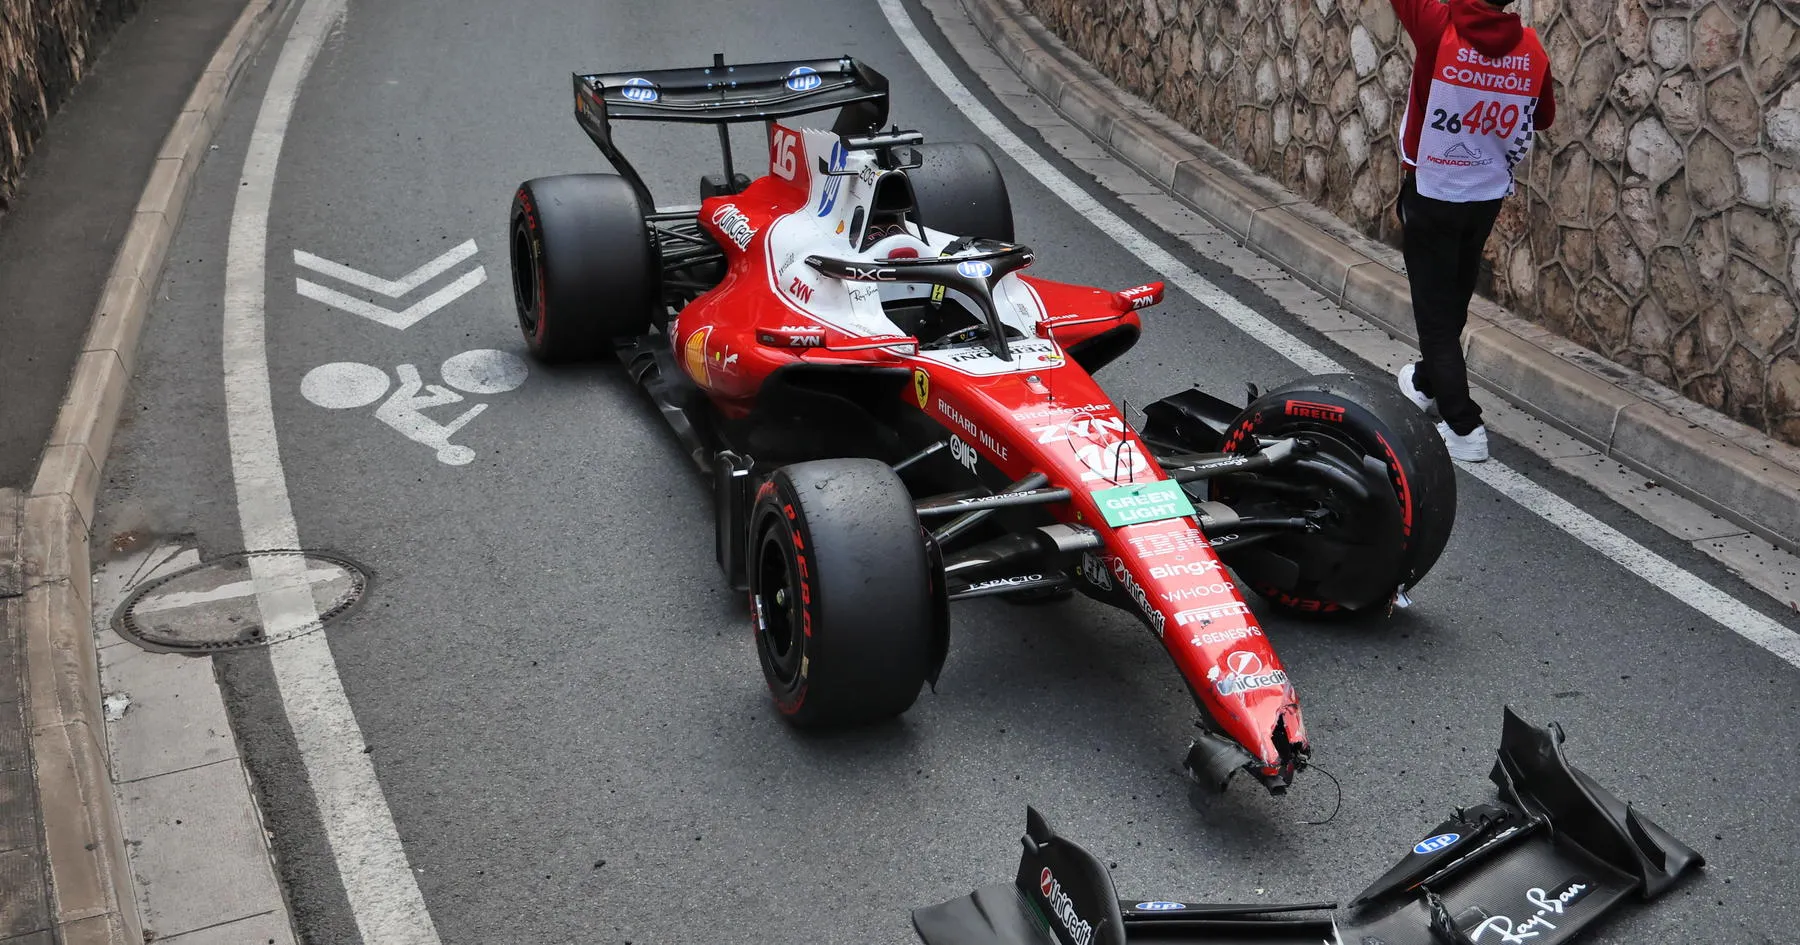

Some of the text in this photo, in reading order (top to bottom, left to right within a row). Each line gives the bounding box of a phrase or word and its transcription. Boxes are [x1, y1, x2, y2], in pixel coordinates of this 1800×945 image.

[1442, 65, 1532, 92] CONTRÔLE
[772, 129, 797, 181] 16
[960, 261, 989, 278] hp
[789, 277, 814, 304] ZYN
[1132, 295, 1153, 309] ZYN
[789, 335, 820, 346] ZYN
[1011, 403, 1112, 421] Bitdefender
[1285, 400, 1346, 423] PIRELLI
[938, 398, 1008, 461] RICHARD MILLE
[1030, 416, 1131, 445] ZYN
[1076, 440, 1147, 481] 16
[1197, 454, 1249, 471] vantage
[978, 489, 1037, 503] vantage
[1106, 490, 1178, 509] GREEN
[1118, 502, 1178, 522] LIGHT
[1128, 527, 1210, 559] IBM
[969, 574, 1043, 591] ESPACIO
[1161, 581, 1235, 602] WHOOP
[1123, 569, 1166, 638] UniCredit
[1174, 601, 1250, 626] PIRELLI
[1202, 626, 1262, 644] GENESYS
[1417, 833, 1456, 853] hp
[1050, 880, 1092, 945] UniCredit
[1470, 883, 1586, 944] Ray-Ban
